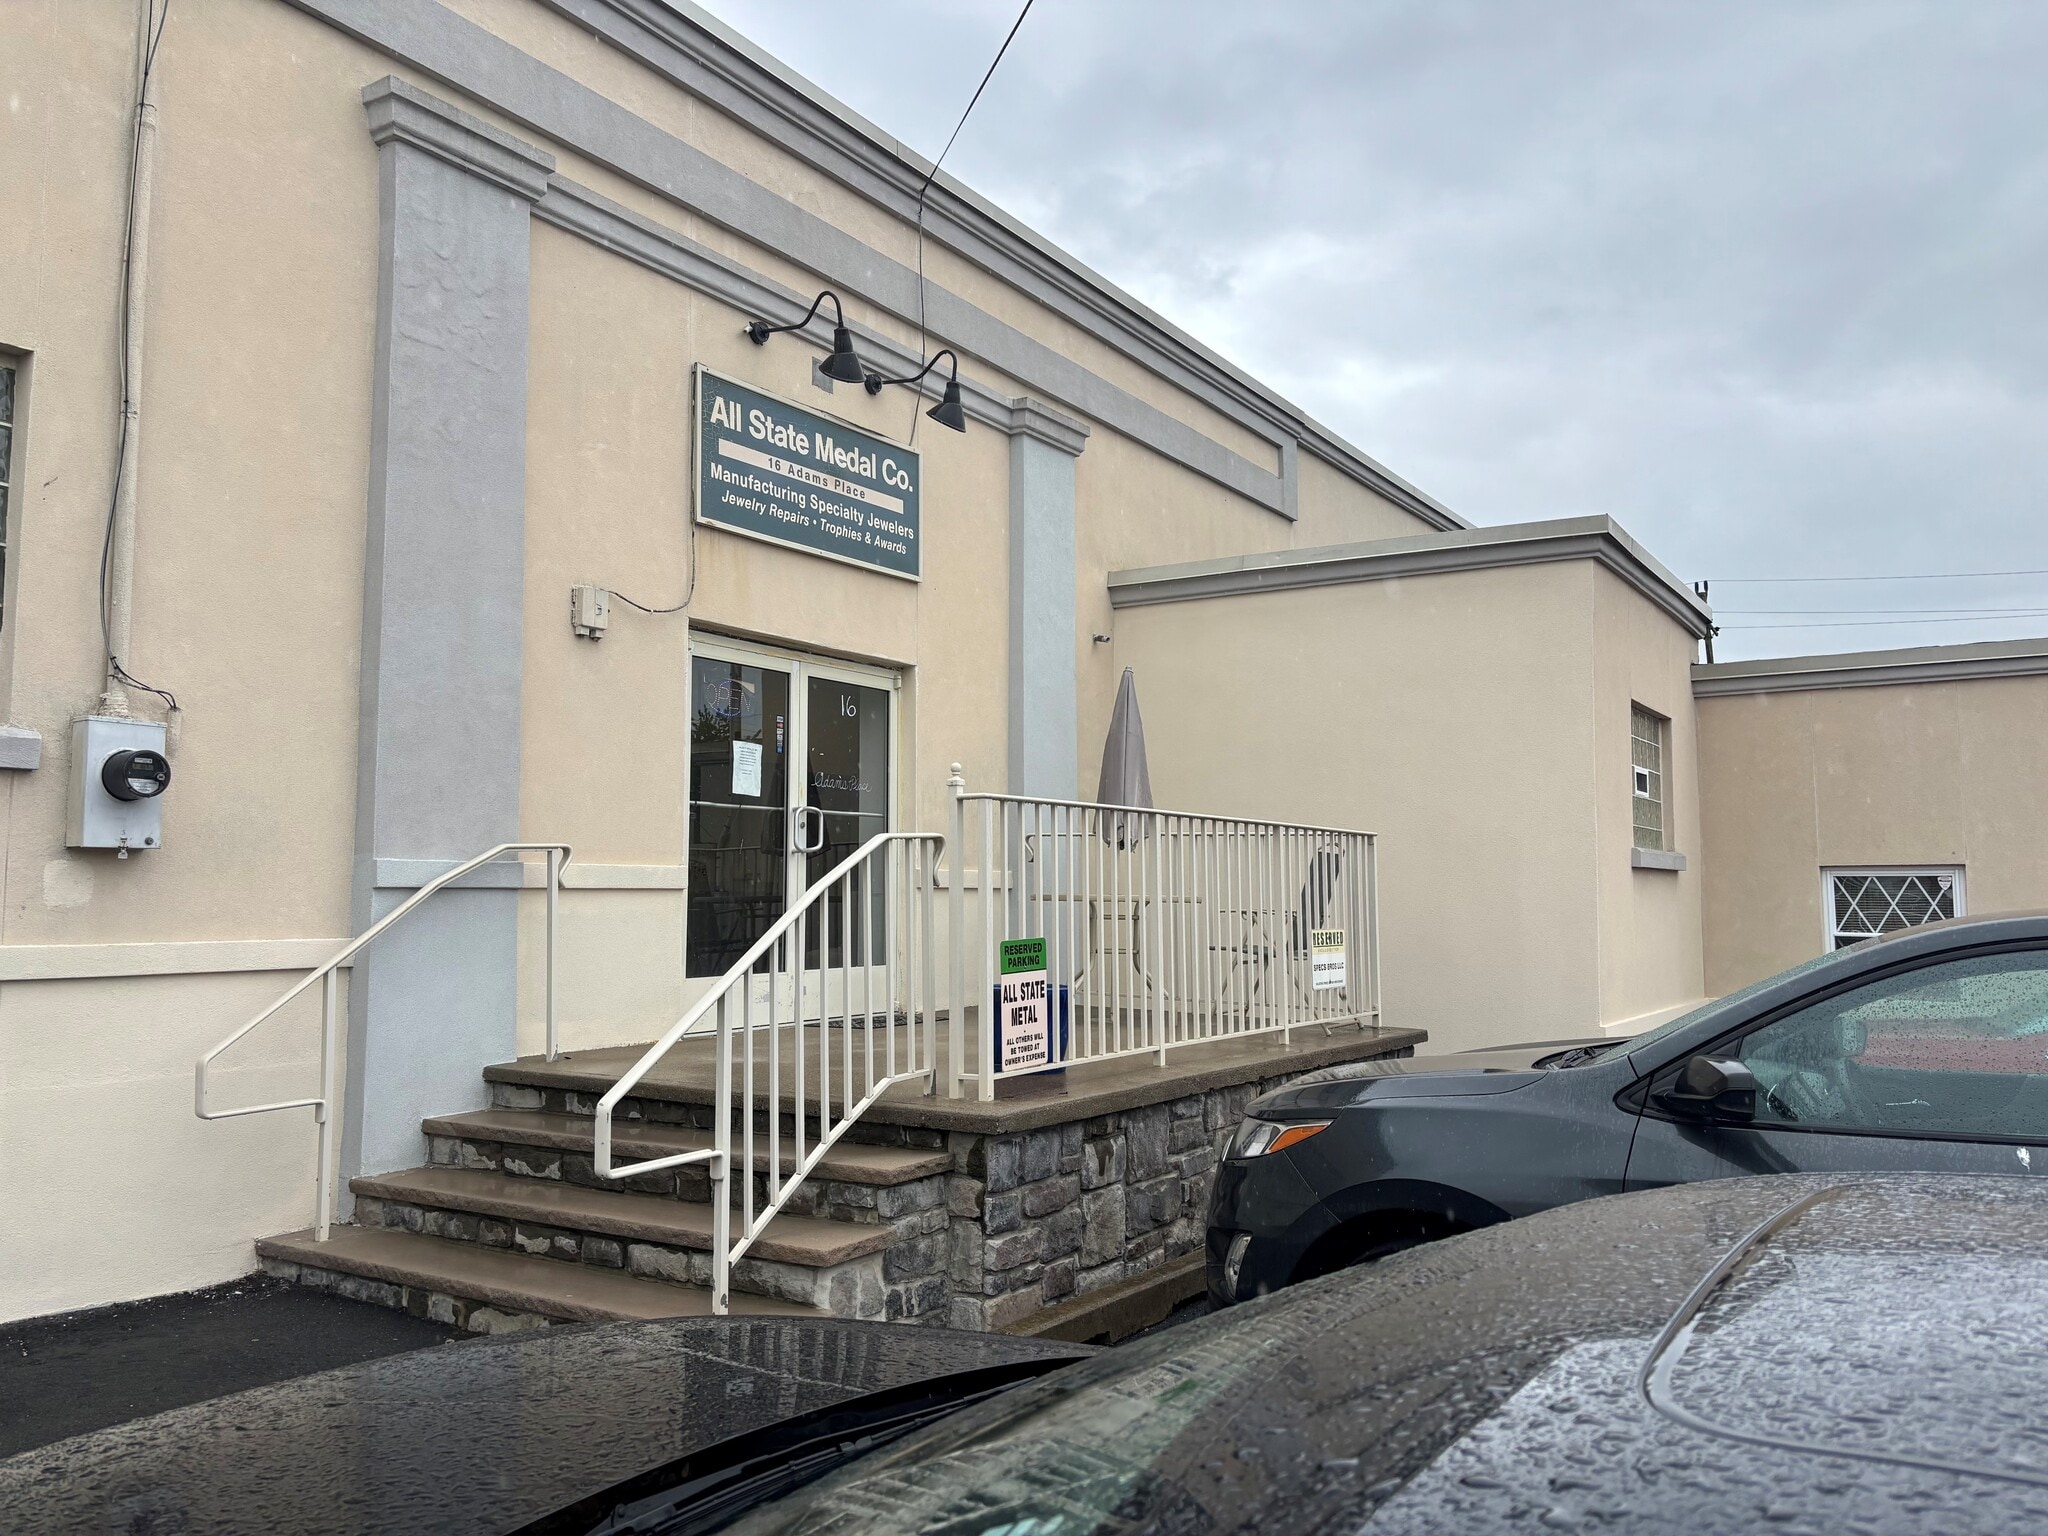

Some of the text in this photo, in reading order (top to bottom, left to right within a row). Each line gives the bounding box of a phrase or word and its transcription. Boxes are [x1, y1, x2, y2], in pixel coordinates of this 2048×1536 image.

[710, 396, 914, 492] All State Medal Co.
[768, 456, 866, 499] 16 Adams Place
[710, 462, 914, 540] Manufacturing Specialty Jewelers
[721, 490, 907, 555] Jewelry Repairs Trophies & Awards
[706, 682, 751, 713] OPEN
[841, 694, 857, 717] 16
[1004, 942, 1043, 956] RESERVED
[1313, 932, 1343, 945] RESERVED
[1008, 955, 1040, 969] PARKING
[1313, 963, 1326, 971] SPECS
[1003, 980, 1045, 1004] ALL STATE
[1011, 1004, 1038, 1027] METAL
[1006, 1032, 1044, 1046] ALL OTHERS WILL
[1010, 1042, 1040, 1055] BE TOWED AT
[1004, 1051, 1046, 1066] OWNER'S EXPENSE
